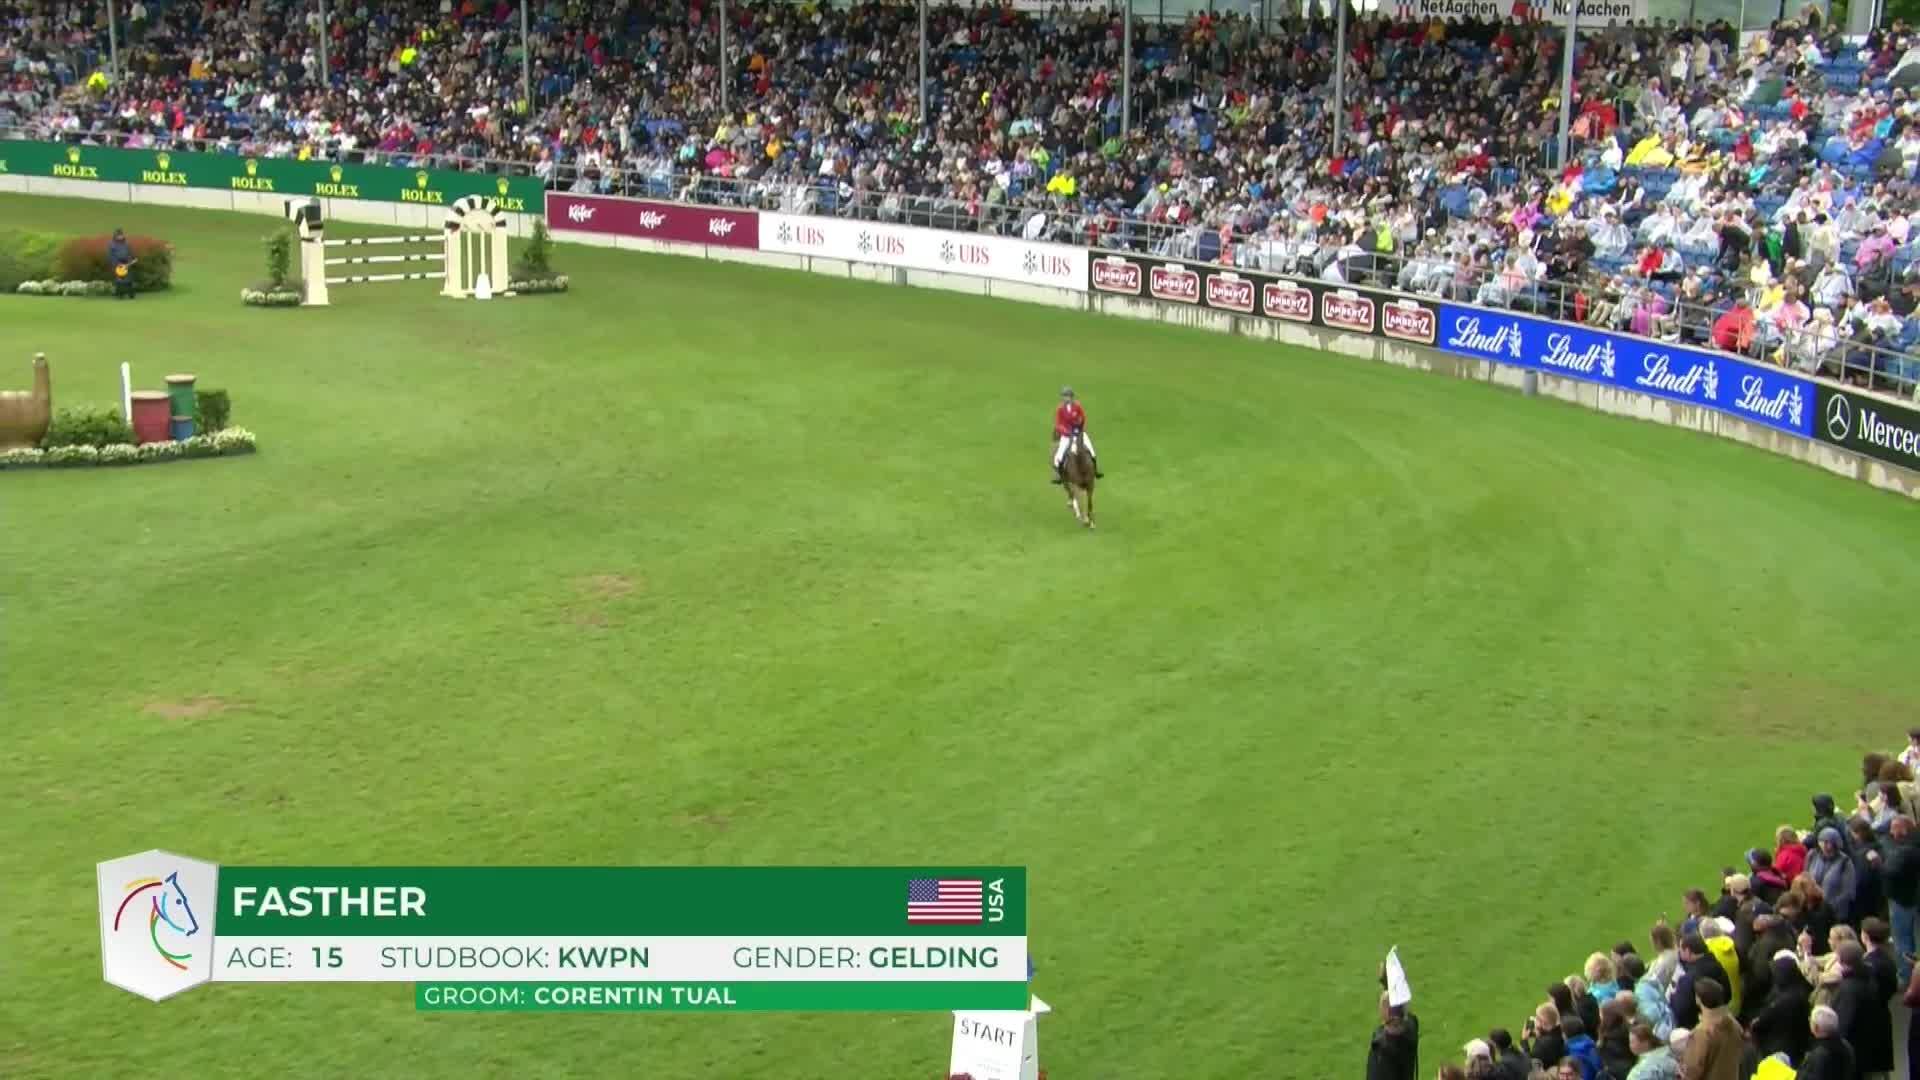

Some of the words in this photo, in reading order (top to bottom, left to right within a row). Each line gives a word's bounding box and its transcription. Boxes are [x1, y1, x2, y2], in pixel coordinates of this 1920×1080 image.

[1420, 0, 1497, 14] NetAachen
[1552, 0, 1631, 16] NAachen
[53, 164, 98, 178] ROLEX
[143, 170, 188, 185] ROLEX
[231, 176, 275, 191] ROLEX
[315, 182, 359, 197] ROLEX
[401, 188, 444, 204] ROLEX
[796, 227, 825, 246] UBS
[876, 236, 905, 256] UBS
[959, 244, 990, 265] UBS
[1041, 255, 1072, 276] UBS
[1448, 316, 1509, 354] Lindt
[1540, 332, 1601, 373] Lindt
[1635, 352, 1704, 396] Lindt
[1735, 375, 1790, 421] Lindt
[961, 1018, 1017, 1047] START
